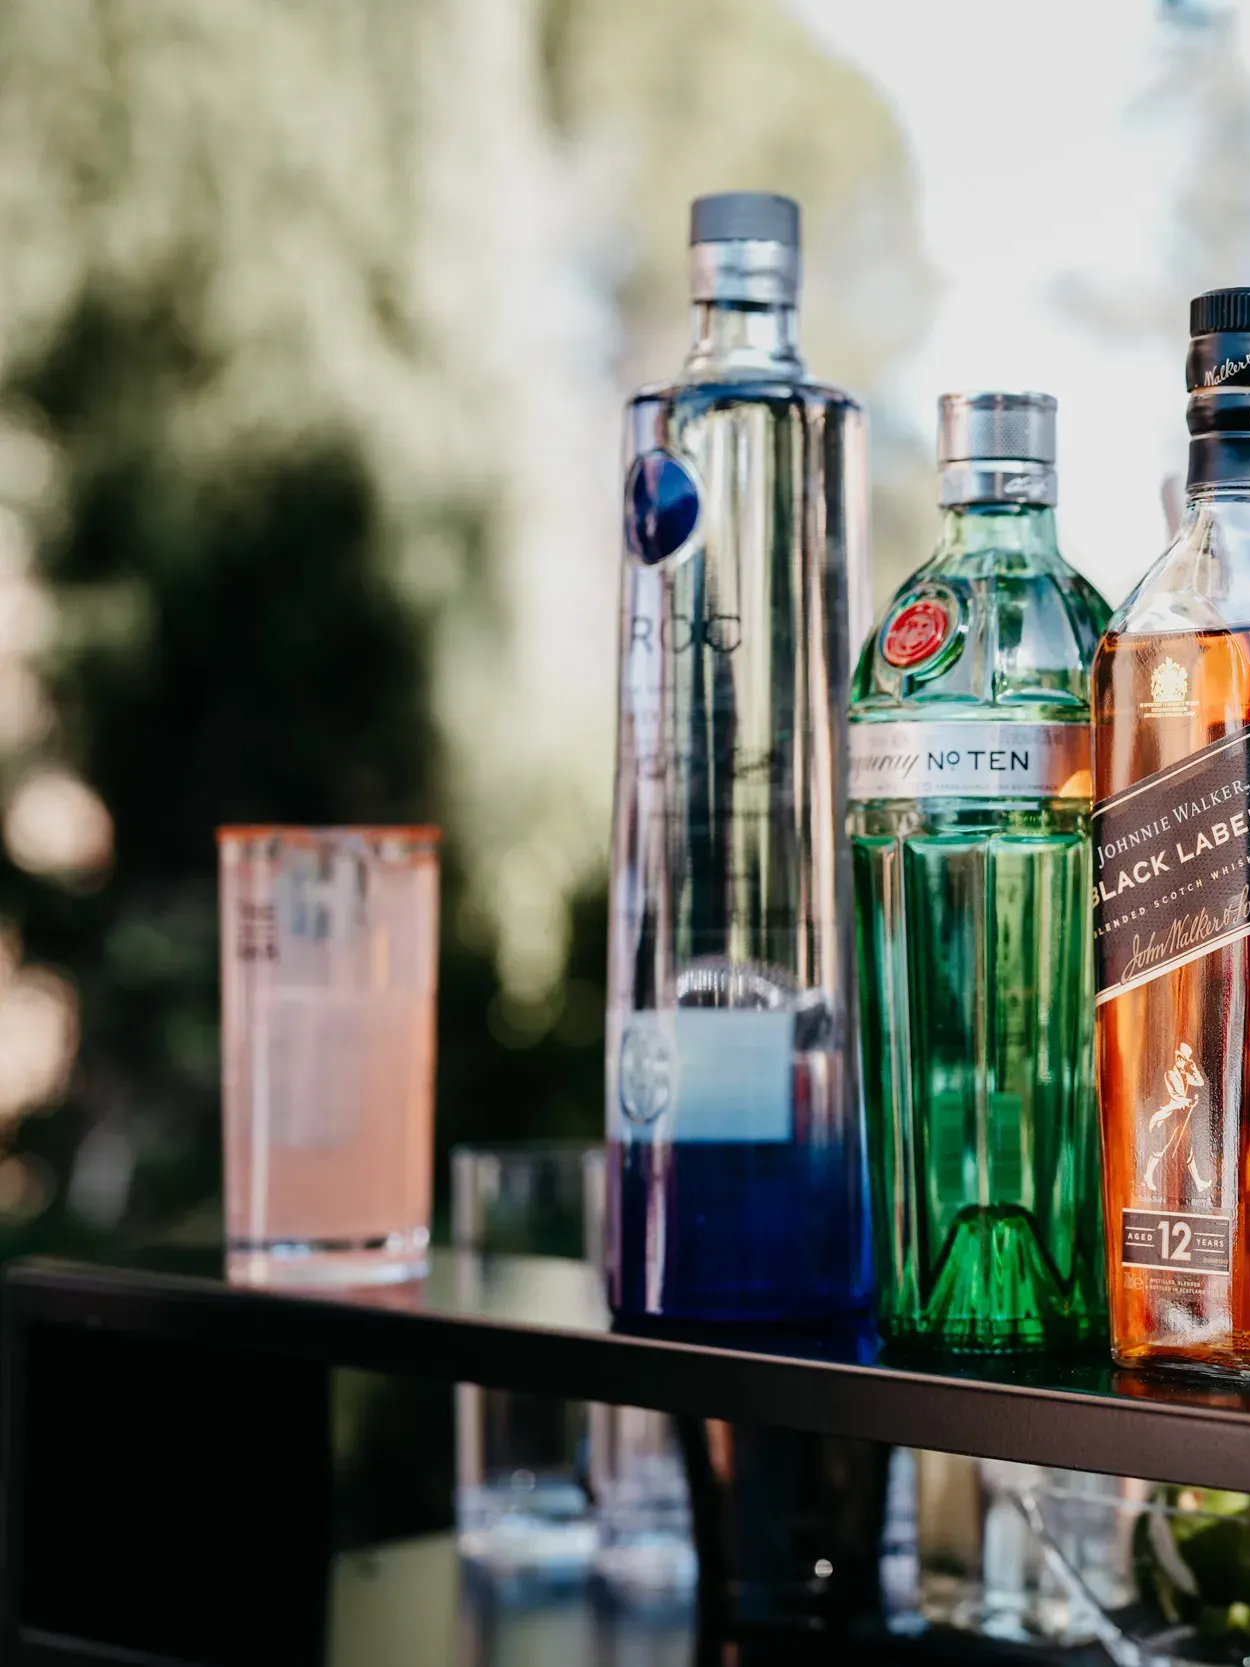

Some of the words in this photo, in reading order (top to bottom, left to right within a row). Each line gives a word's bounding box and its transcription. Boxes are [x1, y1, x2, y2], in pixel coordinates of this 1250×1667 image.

[1204, 358, 1247, 387] Walker
[967, 751, 1029, 770] TEN
[1097, 815, 1171, 869] JOHNNIE
[1172, 779, 1246, 824] WALKER
[1092, 850, 1171, 909] BLACK
[1153, 879, 1204, 909] SCOTCH
[1127, 1232, 1153, 1242] AGED
[1157, 1220, 1192, 1262] 12
[1196, 1238, 1225, 1248] YEARS
